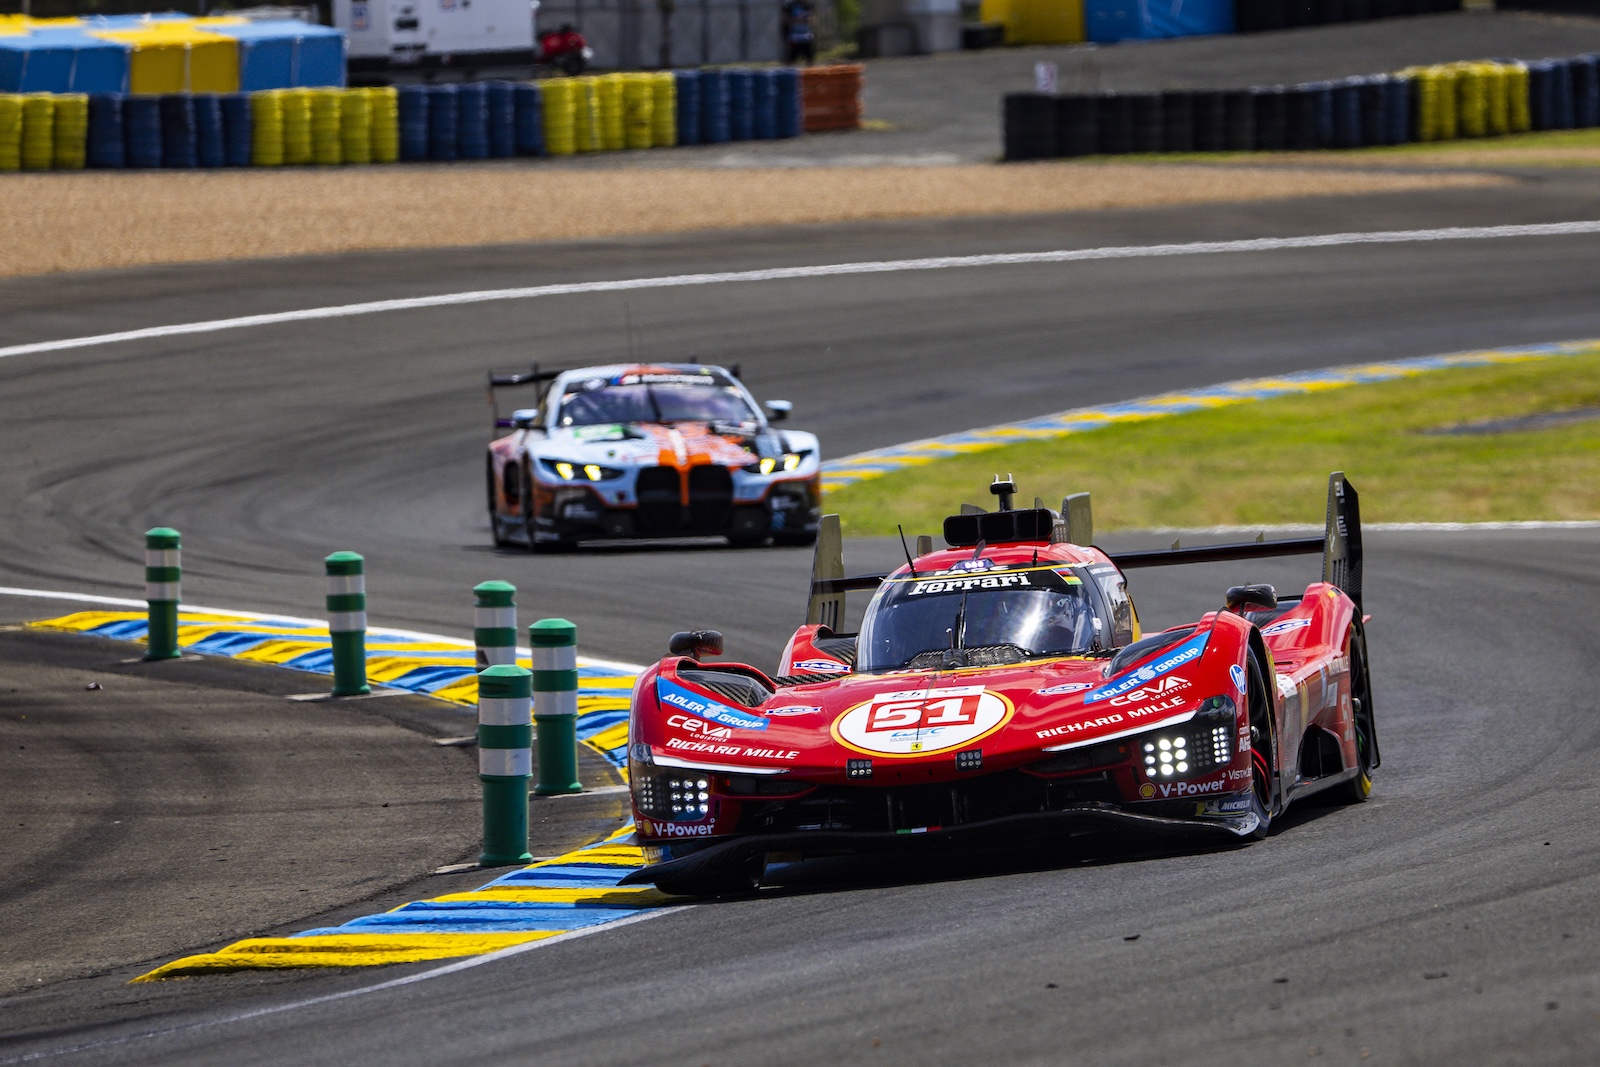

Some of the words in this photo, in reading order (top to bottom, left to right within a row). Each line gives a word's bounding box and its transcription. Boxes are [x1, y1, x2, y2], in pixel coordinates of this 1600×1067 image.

[908, 573, 1031, 595] Ferrari
[1092, 679, 1141, 700] ADLER
[1155, 648, 1199, 672] GROUP
[1150, 682, 1192, 701] LOGISTICS
[663, 693, 705, 713] ADLER
[718, 714, 764, 729] GROUP
[872, 697, 969, 728] 51
[1037, 714, 1124, 739] RICHARD
[1127, 696, 1186, 718] MILLE
[690, 732, 727, 743] LOGISTICS
[666, 738, 740, 755] RICHARD
[742, 749, 800, 759] MILLE
[1160, 780, 1225, 797] V-Power
[653, 823, 715, 837] V-Power
